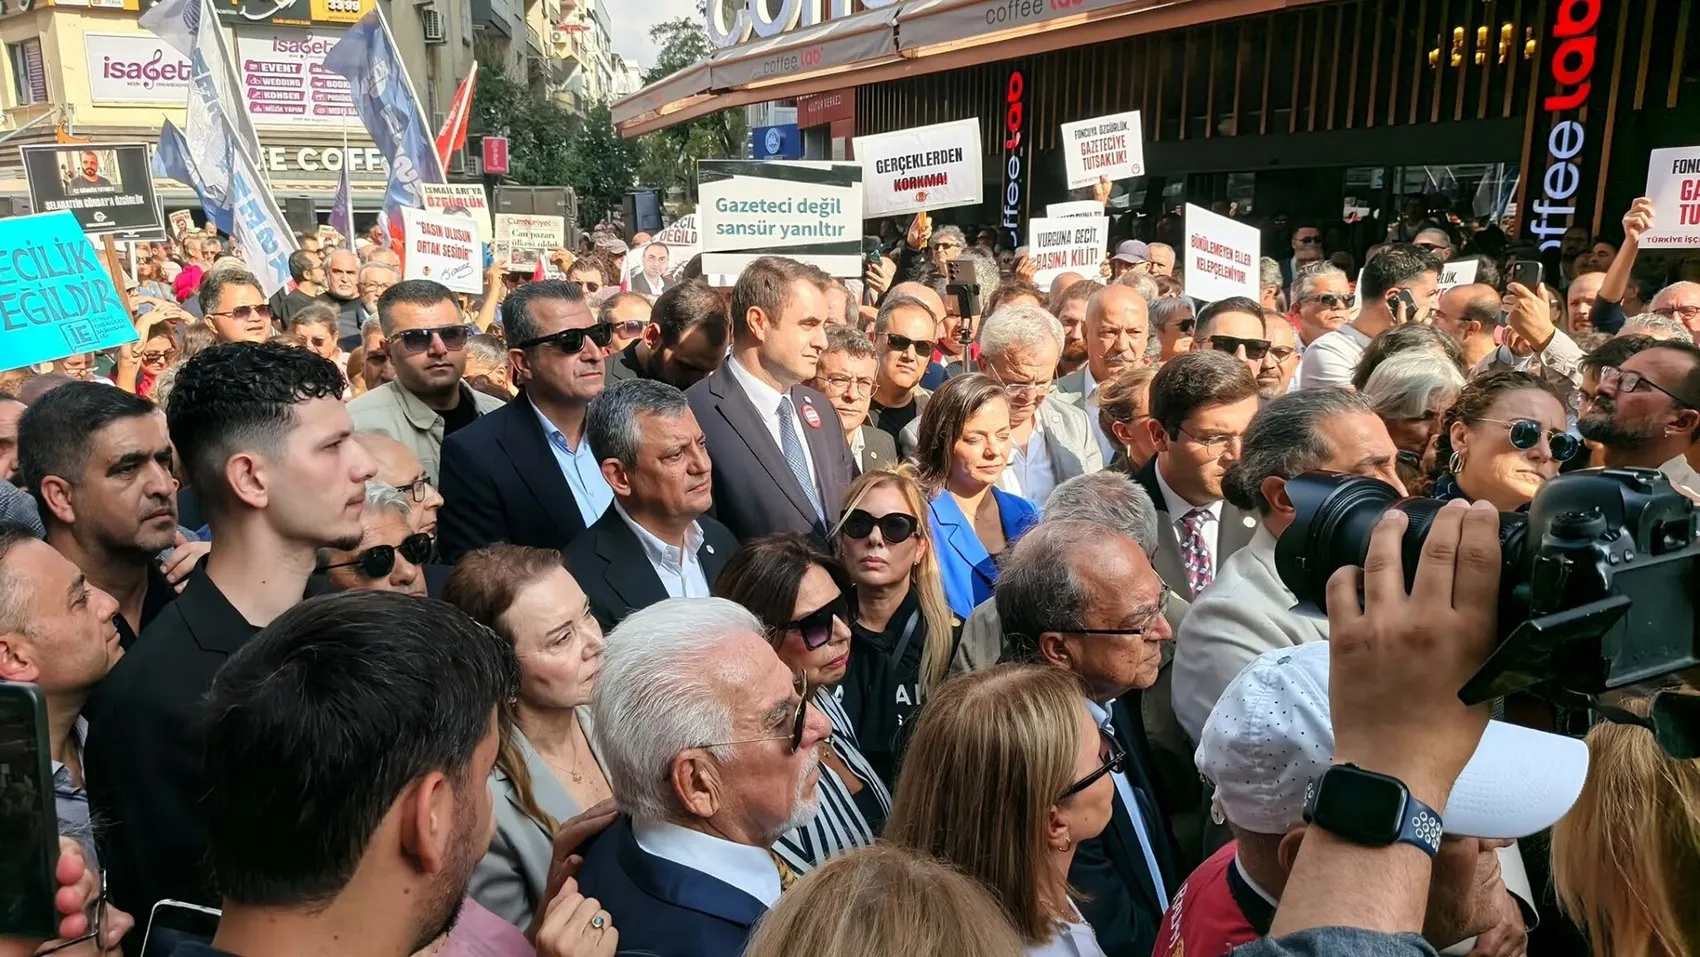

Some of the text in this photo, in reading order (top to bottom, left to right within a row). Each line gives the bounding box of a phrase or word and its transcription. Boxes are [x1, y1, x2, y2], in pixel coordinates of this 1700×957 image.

[986, 0, 1043, 25] coffee
[261, 64, 298, 73] EVENT
[763, 48, 821, 74] coffee lab
[262, 78, 301, 88] WEDDING
[263, 91, 301, 101] KONSER
[1006, 71, 1024, 149] lab
[1080, 134, 1126, 156] GAZETECİYE
[297, 146, 381, 171] COFF
[875, 147, 963, 176] GERÇEKLERDEN
[1082, 150, 1127, 171] TUTSAKLIK!
[1672, 158, 1700, 174] FONC
[893, 171, 948, 193] KORKMA!
[1680, 179, 1700, 201] GA
[427, 195, 485, 209] ÖZGÜRLÜK
[715, 197, 841, 218] Gazeteci değil
[1680, 203, 1700, 226] TU
[716, 220, 845, 240] sansür yanıltır
[1037, 229, 1072, 248] VURGUNA
[1646, 235, 1683, 244] TÜRKİYE
[1036, 246, 1098, 270] BASINA KİLİT!
